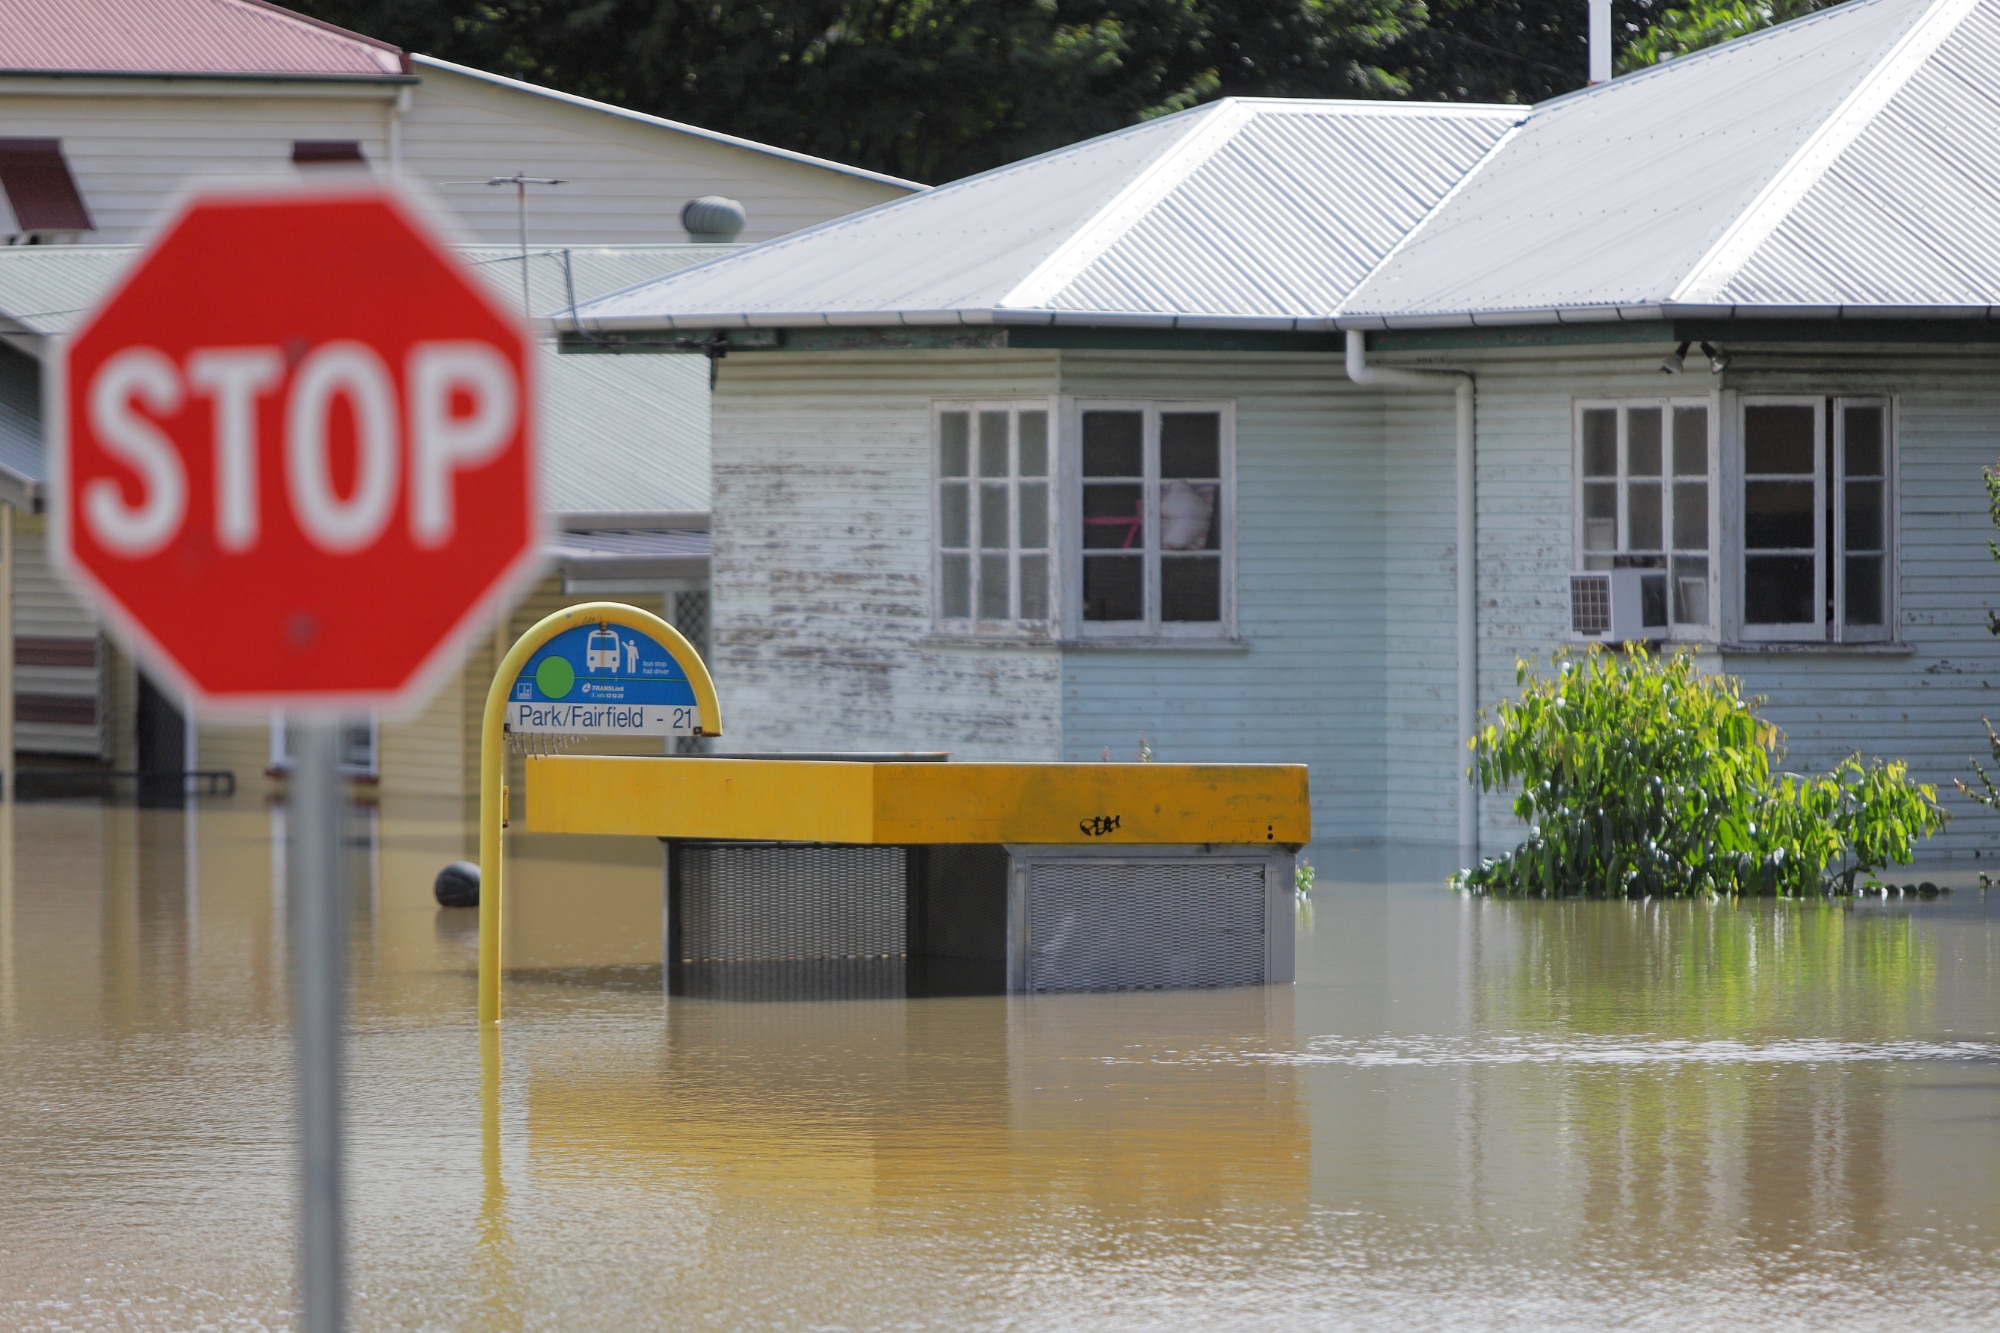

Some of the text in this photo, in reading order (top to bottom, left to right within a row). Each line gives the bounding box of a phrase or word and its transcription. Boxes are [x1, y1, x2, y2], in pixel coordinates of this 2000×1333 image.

[83, 341, 518, 557] STOP
[654, 660, 667, 668] stop
[519, 704, 643, 728] Park/Fairfield
[672, 707, 692, 729] 21
